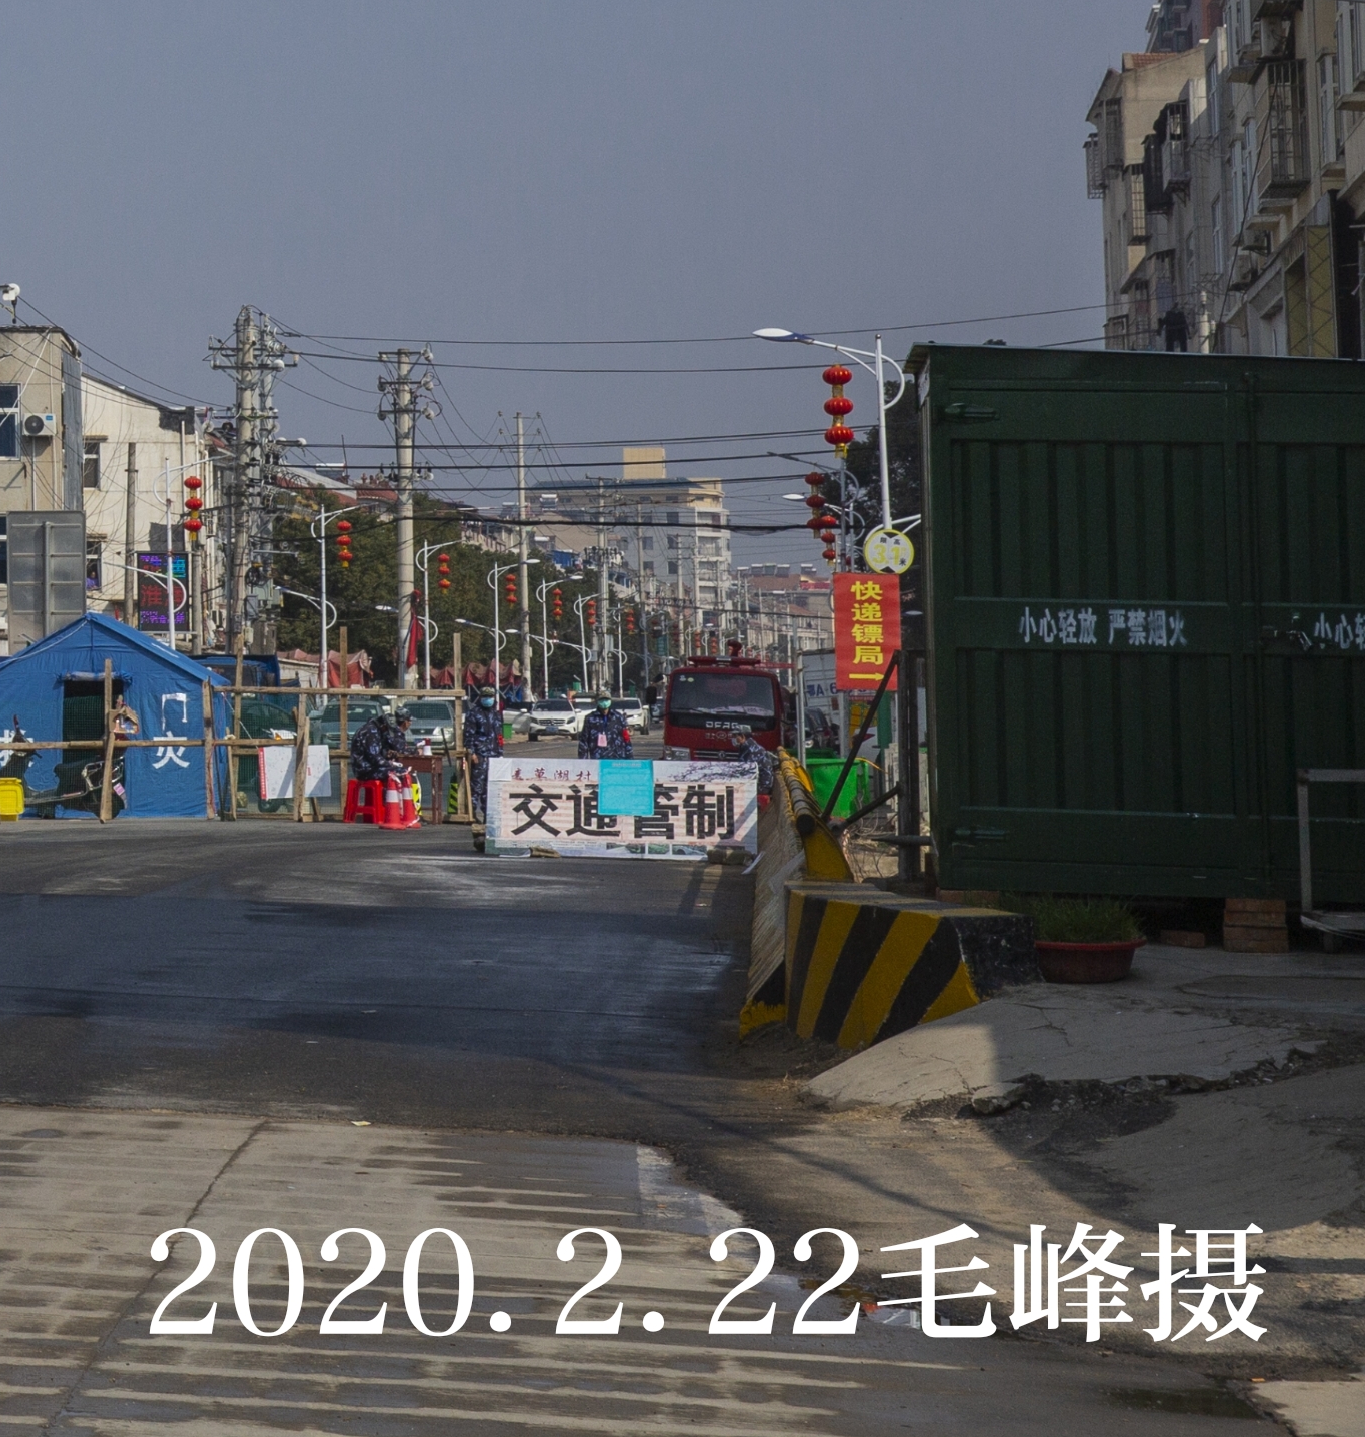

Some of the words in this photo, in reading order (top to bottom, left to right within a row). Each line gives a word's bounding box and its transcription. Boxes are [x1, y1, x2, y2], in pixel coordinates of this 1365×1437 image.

[851, 581, 884, 665] 快递镖局
[1019, 606, 1097, 644] 小心轻放
[1108, 607, 1188, 647] 严禁烟火
[509, 783, 735, 840] 交通管制
